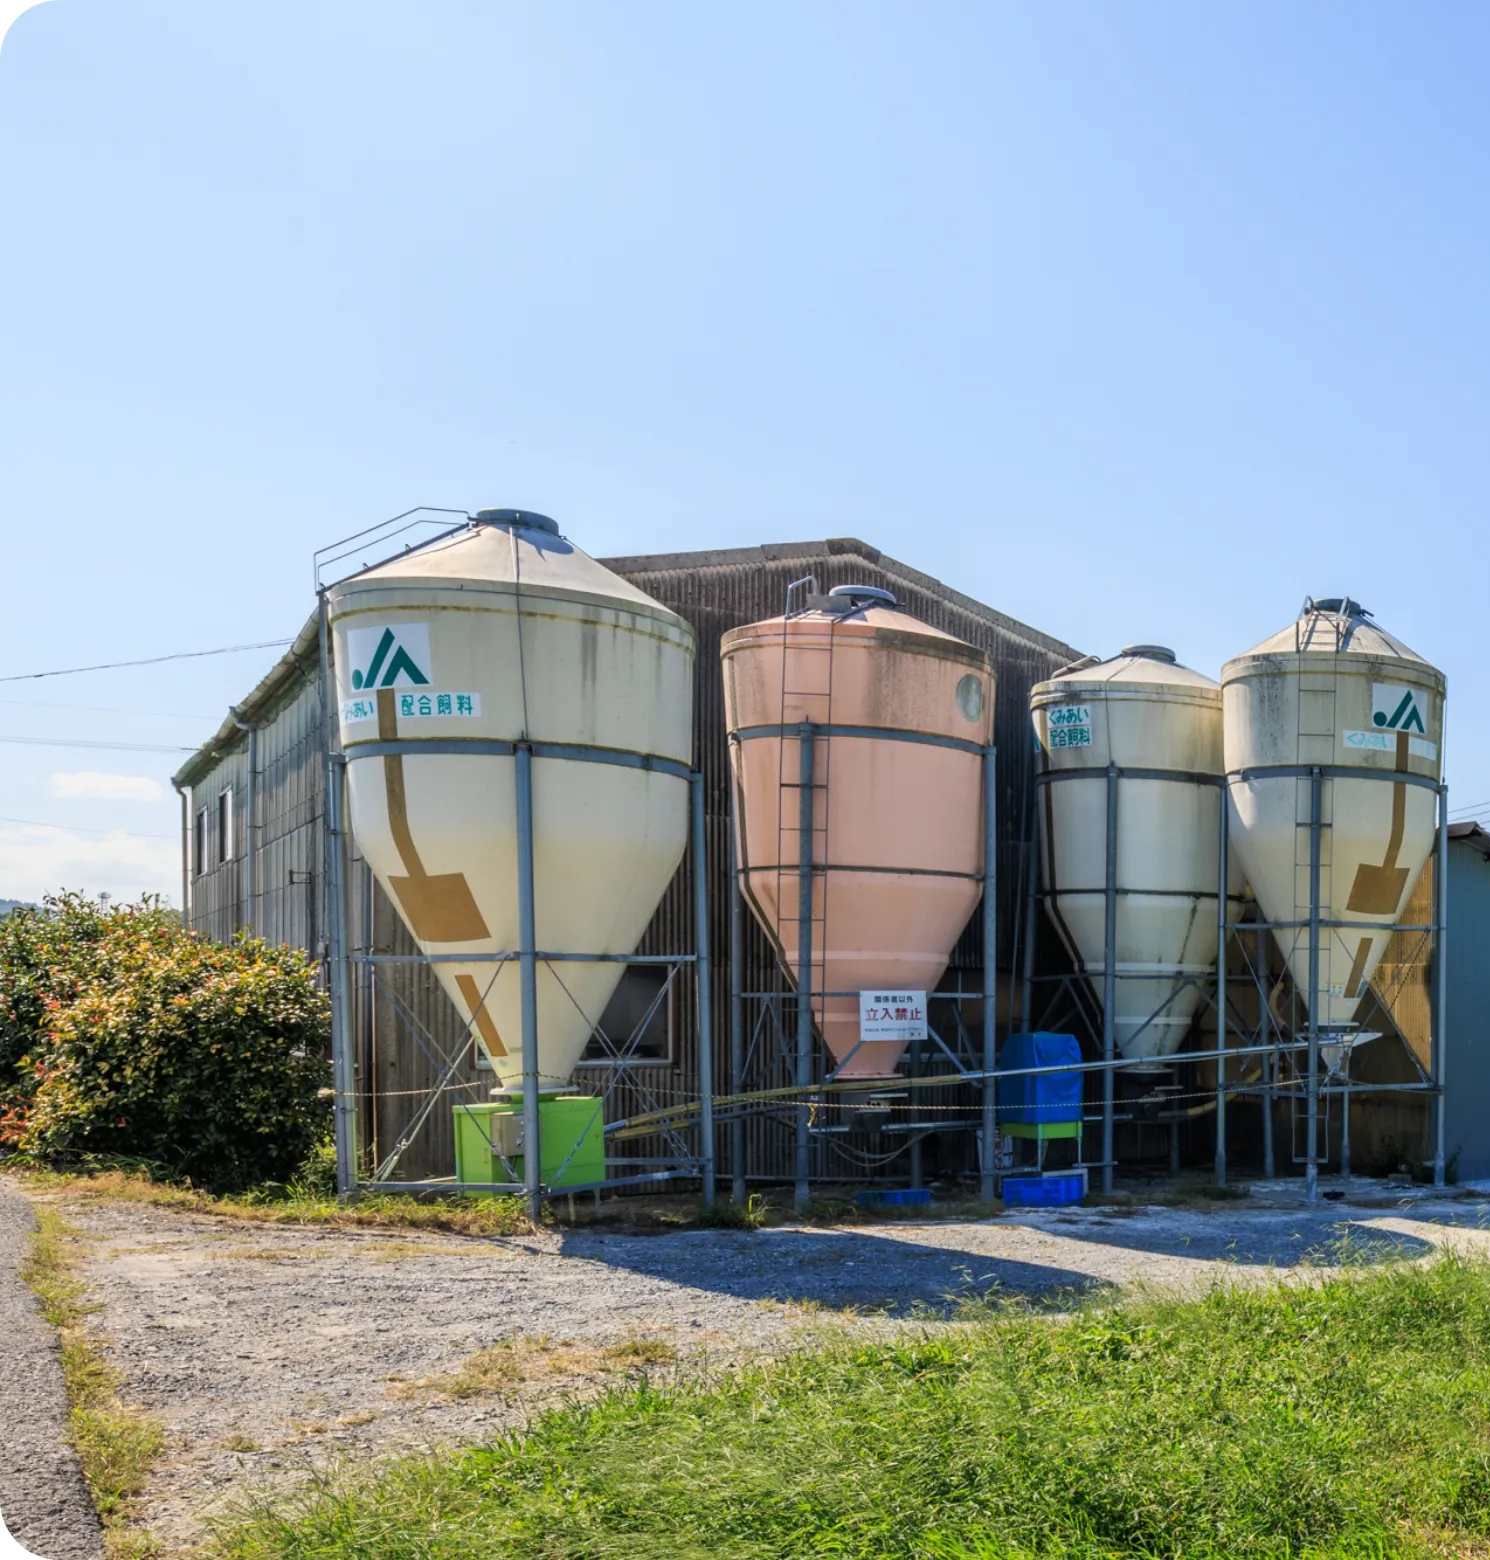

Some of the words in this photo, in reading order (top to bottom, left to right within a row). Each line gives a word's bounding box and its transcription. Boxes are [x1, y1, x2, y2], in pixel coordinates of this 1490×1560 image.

[401, 694, 474, 716] 配合飼料
[1049, 707, 1089, 724] くみあい
[874, 995, 914, 1004] 関係者以外
[865, 1007, 922, 1021] 立入禁止
